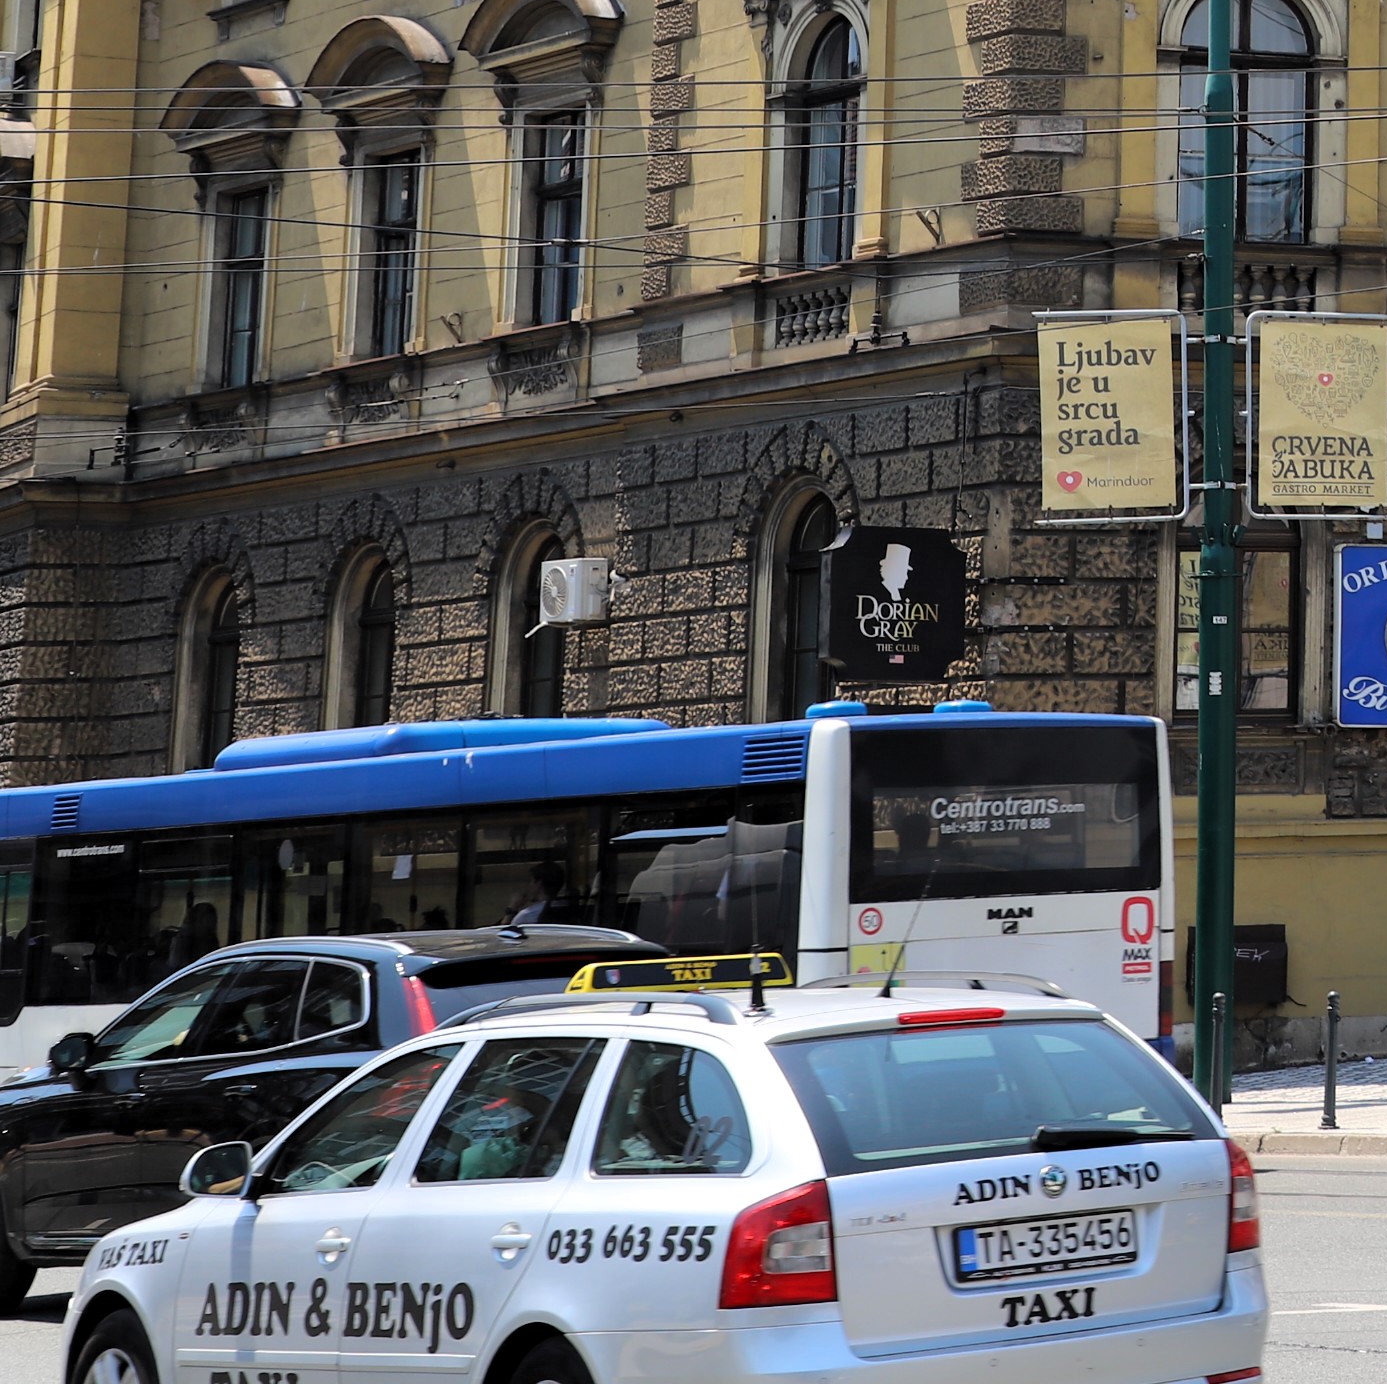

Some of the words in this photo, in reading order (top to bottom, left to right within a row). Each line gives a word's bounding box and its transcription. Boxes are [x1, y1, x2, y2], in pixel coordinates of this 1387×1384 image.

[1056, 340, 1157, 374] Ljubav
[1056, 369, 1082, 401] je
[1091, 376, 1111, 393] u
[1057, 402, 1120, 421] srcu
[1058, 420, 1141, 455] grada
[1271, 436, 1374, 458] CRVENA
[1271, 455, 1375, 480] JABUKA
[1087, 475, 1155, 488] Marinduor
[1273, 484, 1317, 494] GASTRO
[1323, 485, 1371, 495] MARKET
[859, 614, 919, 641] GRAY
[876, 643, 893, 652] THE
[895, 644, 920, 652] CLUB
[930, 796, 1086, 819] Centrotrans.com
[989, 819, 1005, 832] 33
[1007, 818, 1028, 831] 770
[1030, 817, 1052, 830] 888
[863, 914, 879, 929] 50
[987, 907, 1033, 920] MAN
[1122, 896, 1154, 945] Q
[1122, 947, 1153, 962] MAX
[671, 968, 713, 981] TAXI
[953, 1174, 1031, 1206] ADIN
[124, 1239, 170, 1266] TAXI
[546, 1227, 593, 1264] 033
[602, 1225, 648, 1263] 663
[658, 1225, 716, 1262] 555
[977, 1217, 1131, 1264] TA-335456
[195, 1280, 295, 1338] ADIN
[305, 1278, 331, 1335] &
[1000, 1287, 1096, 1327] TAXI
